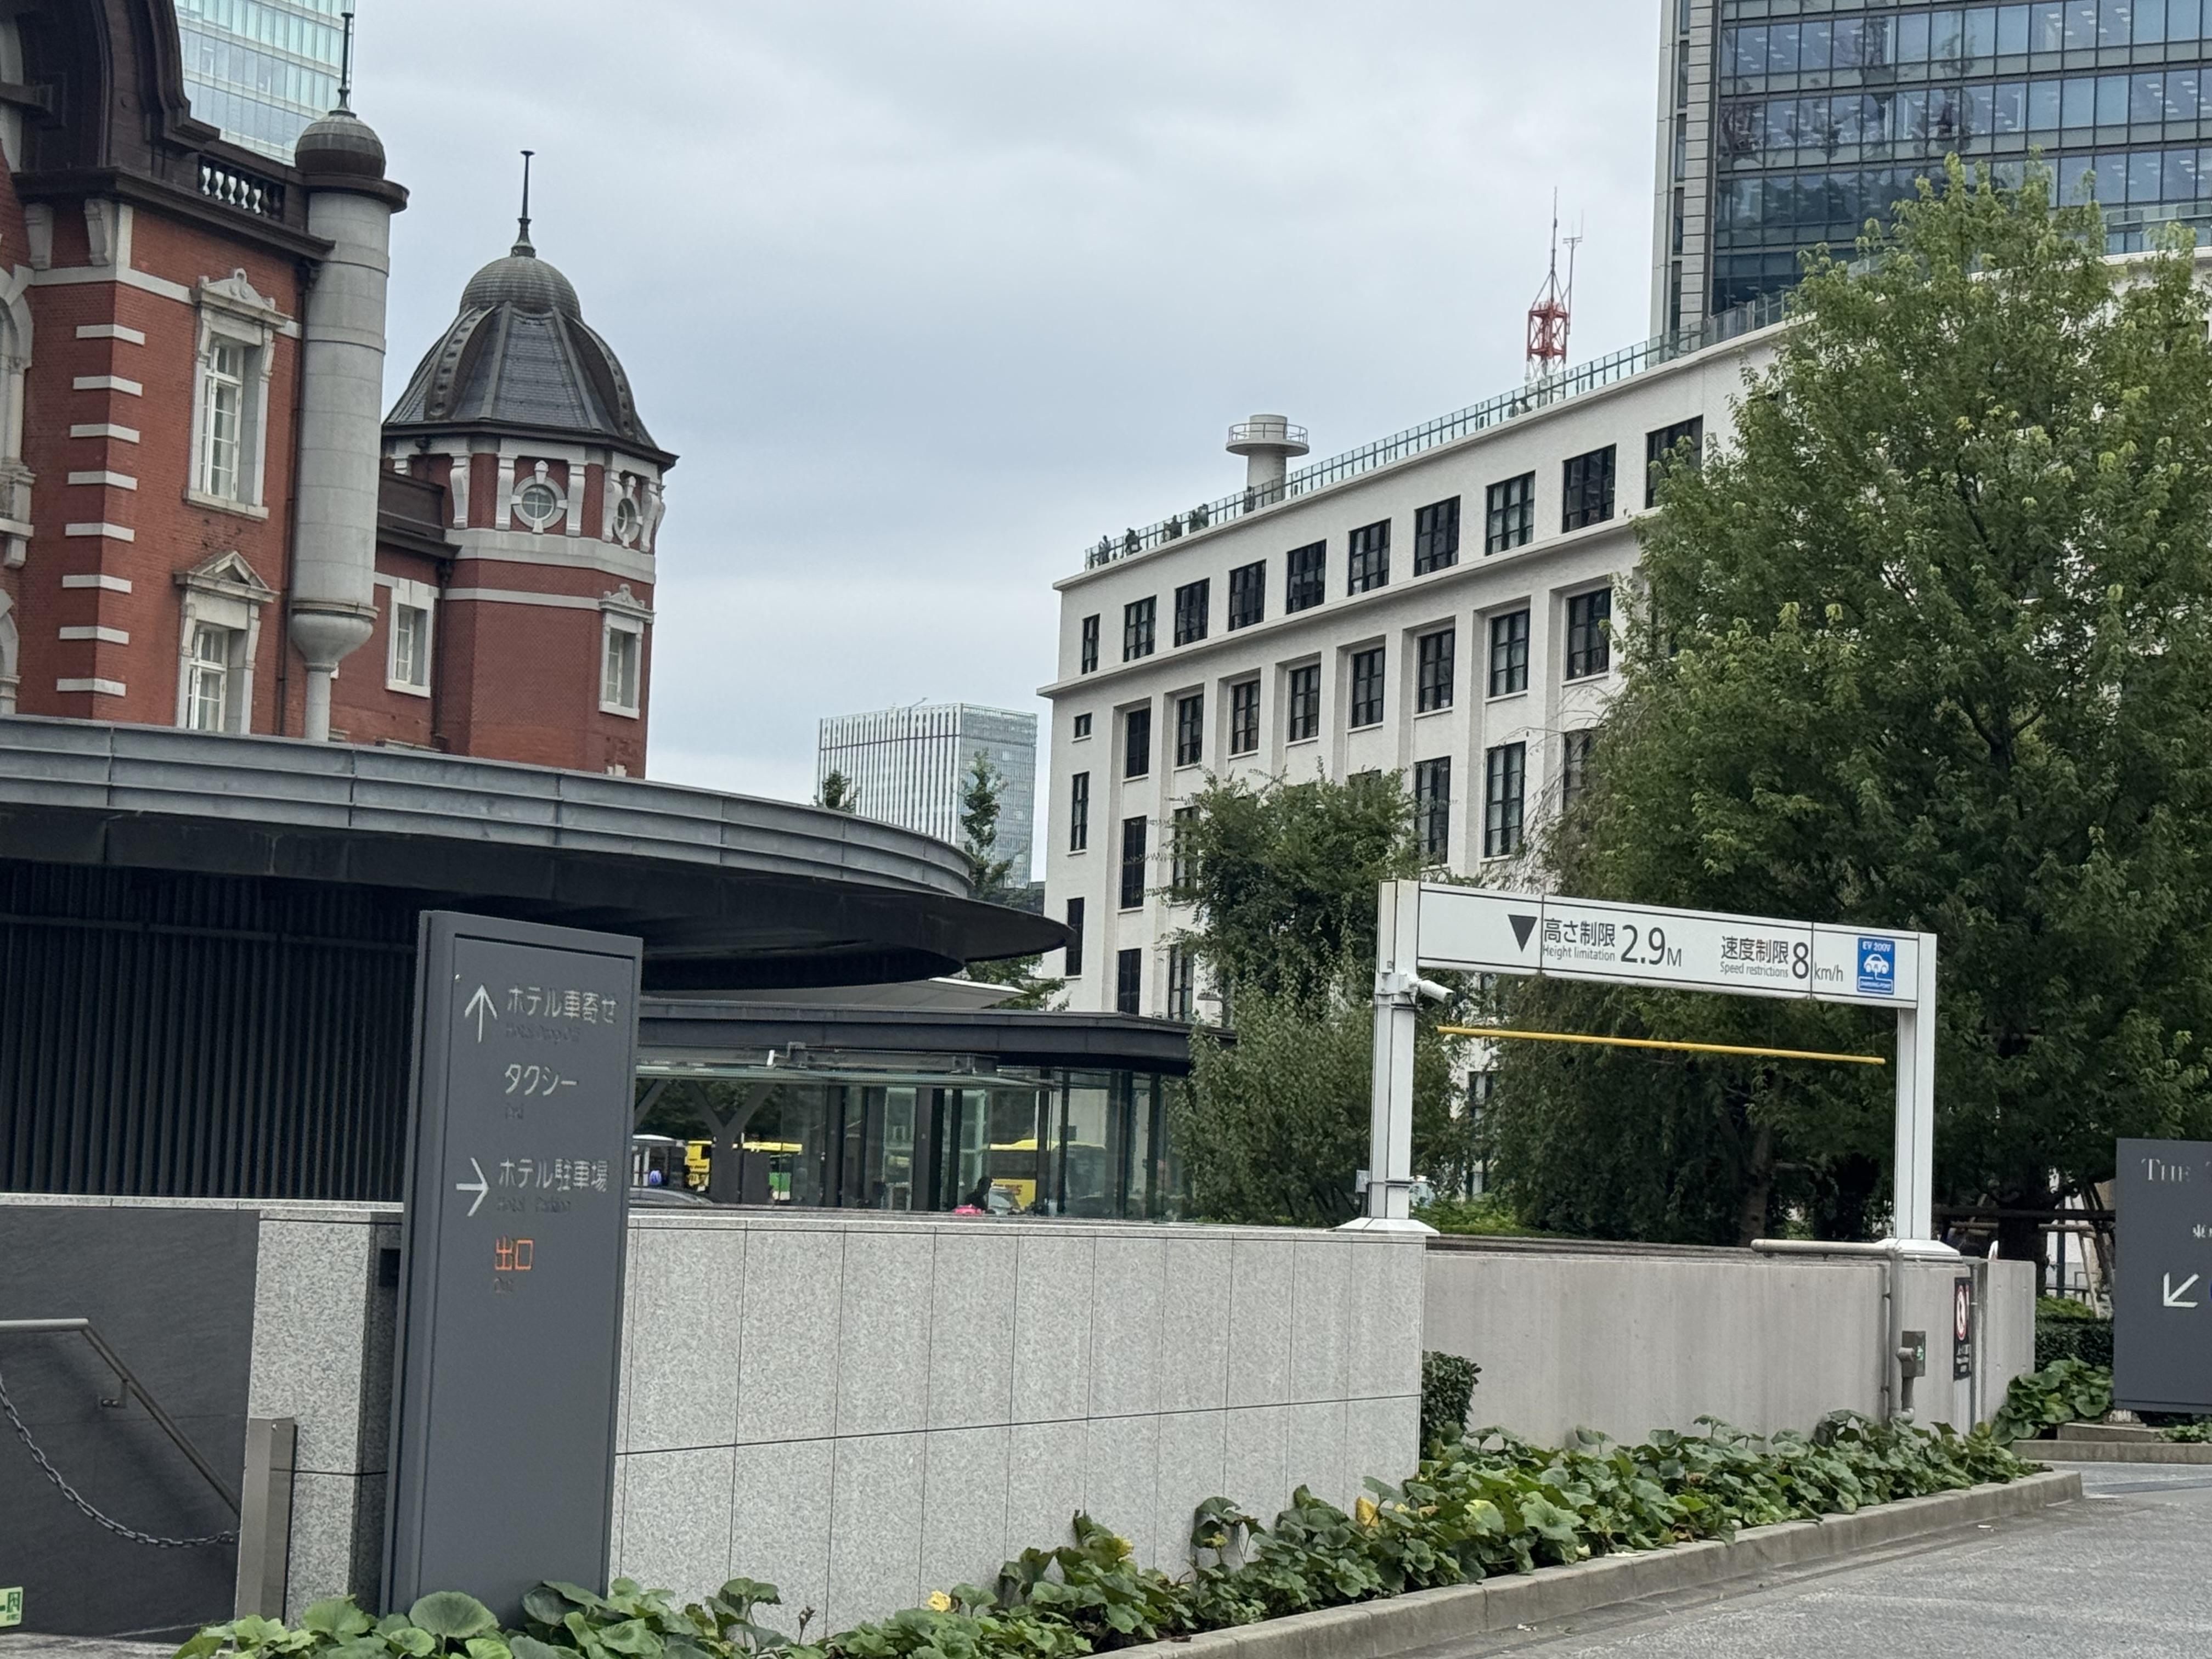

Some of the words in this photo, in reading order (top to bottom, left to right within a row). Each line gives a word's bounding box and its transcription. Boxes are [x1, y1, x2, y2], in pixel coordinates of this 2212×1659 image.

[1544, 918, 1615, 947] 高さ制限
[1543, 944, 1572, 960] Height
[1574, 947, 1615, 961] limitation
[1721, 936, 1788, 964] 速度制限
[1720, 961, 1743, 975] Speed
[1746, 966, 1788, 978] restrictions
[507, 985, 616, 1024] ホテル車寄せ
[505, 1064, 577, 1096] タクシー
[499, 1158, 608, 1192] ホテル駐車場
[494, 1235, 534, 1271] 出口
